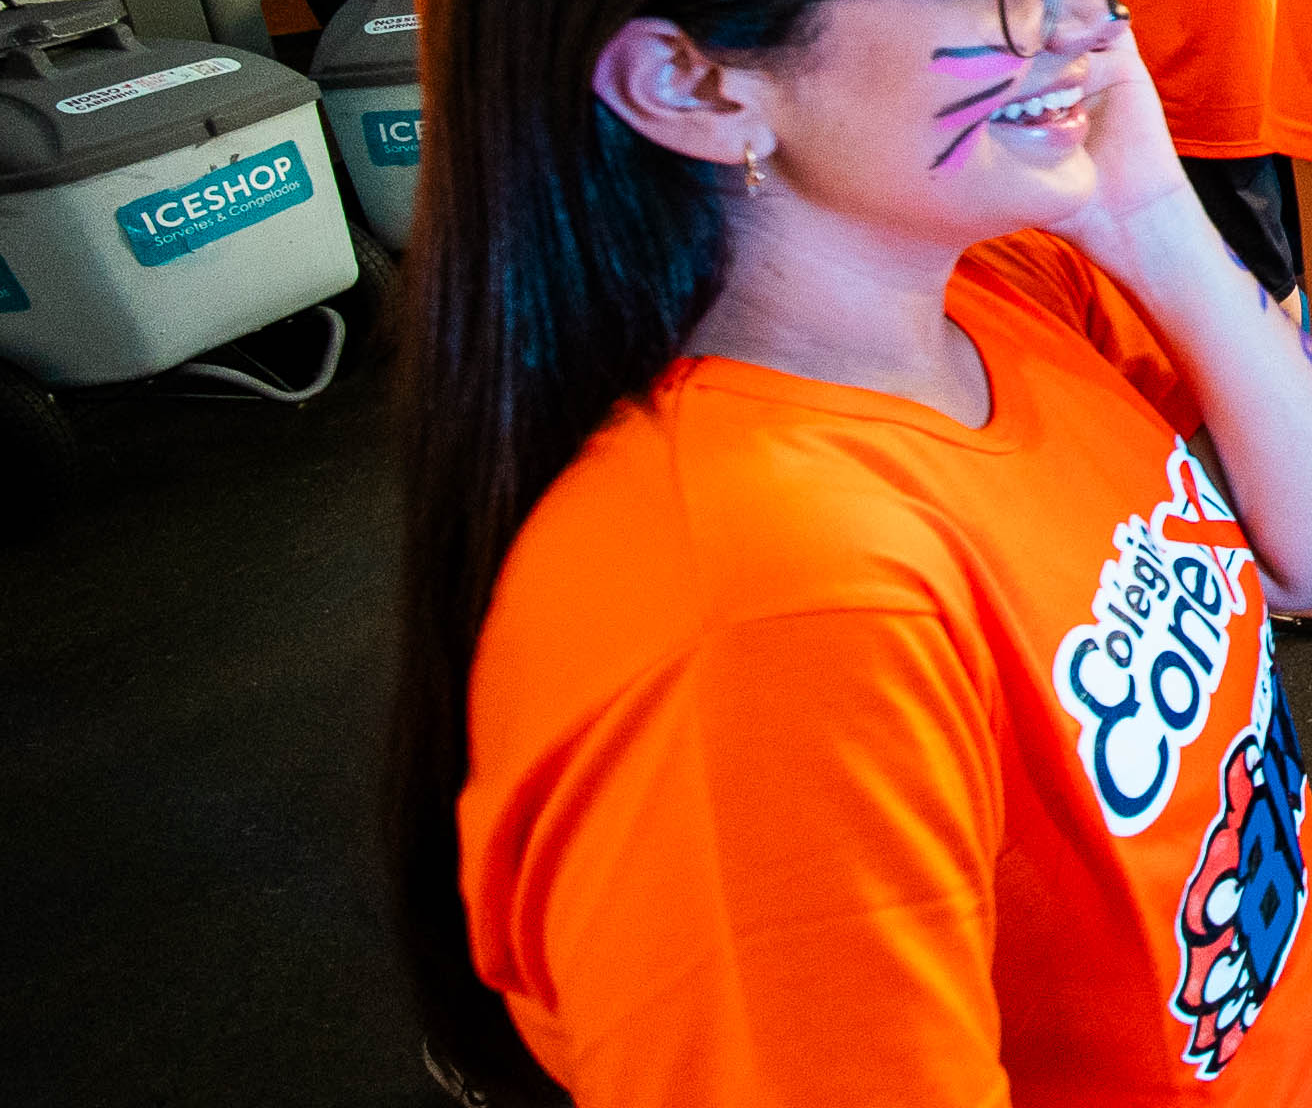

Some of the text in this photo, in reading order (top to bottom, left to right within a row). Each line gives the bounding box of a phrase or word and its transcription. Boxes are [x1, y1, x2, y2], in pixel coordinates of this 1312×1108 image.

[141, 156, 292, 235] ICESHOP
[154, 180, 301, 247] Sorvetes & Congelados
[1069, 525, 1171, 718] Colégi
